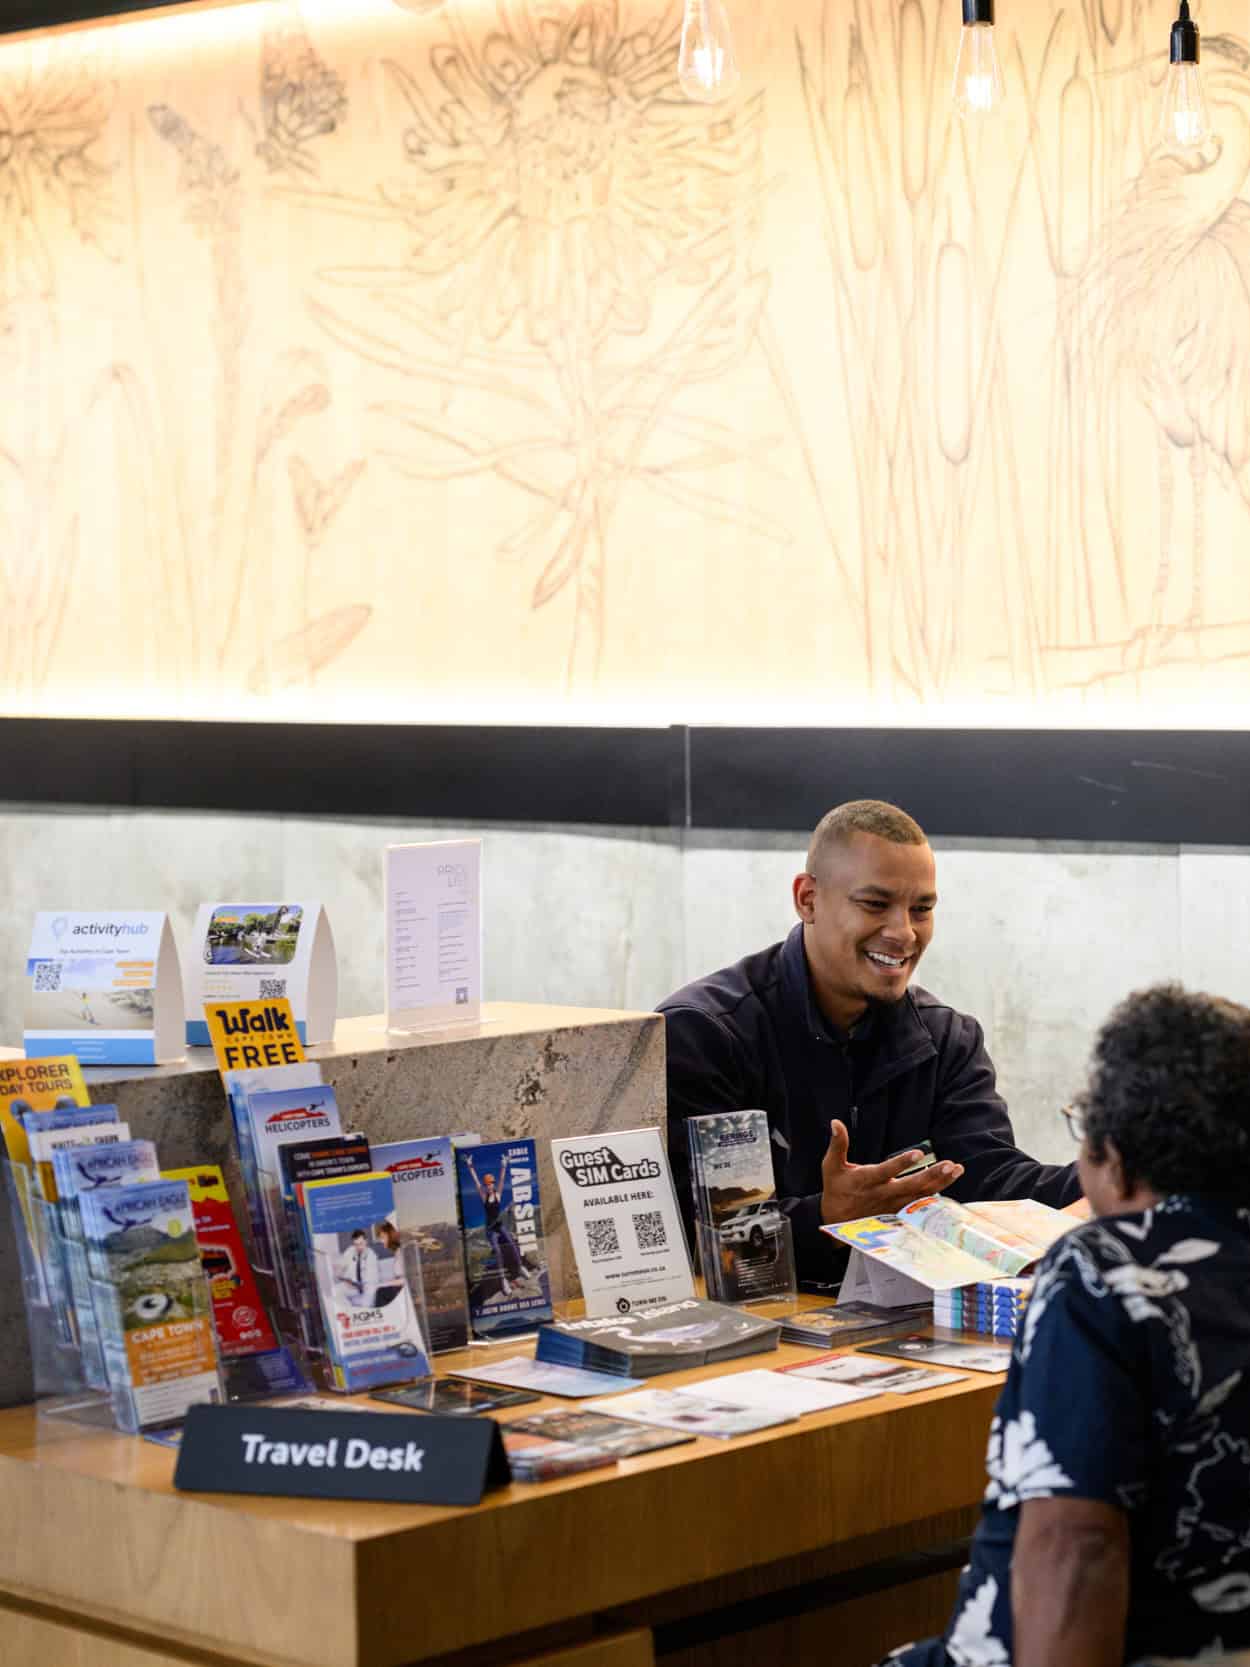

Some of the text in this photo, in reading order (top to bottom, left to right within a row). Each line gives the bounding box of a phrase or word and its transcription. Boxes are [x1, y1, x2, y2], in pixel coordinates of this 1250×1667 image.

[72, 921, 149, 937] activityhub
[216, 1006, 290, 1035] Walk
[224, 1043, 299, 1069] FREE
[29, 1079, 73, 1093] TOURS
[265, 1118, 330, 1134] HELICOPTERS
[561, 1148, 611, 1168] Guest
[575, 1160, 660, 1187] SIM Cards
[583, 1190, 654, 1208] AVAILABLE HERE:
[510, 1167, 538, 1256] ABSEIL
[131, 1328, 165, 1345] CAPE
[241, 1432, 425, 1472] Travel Desk
